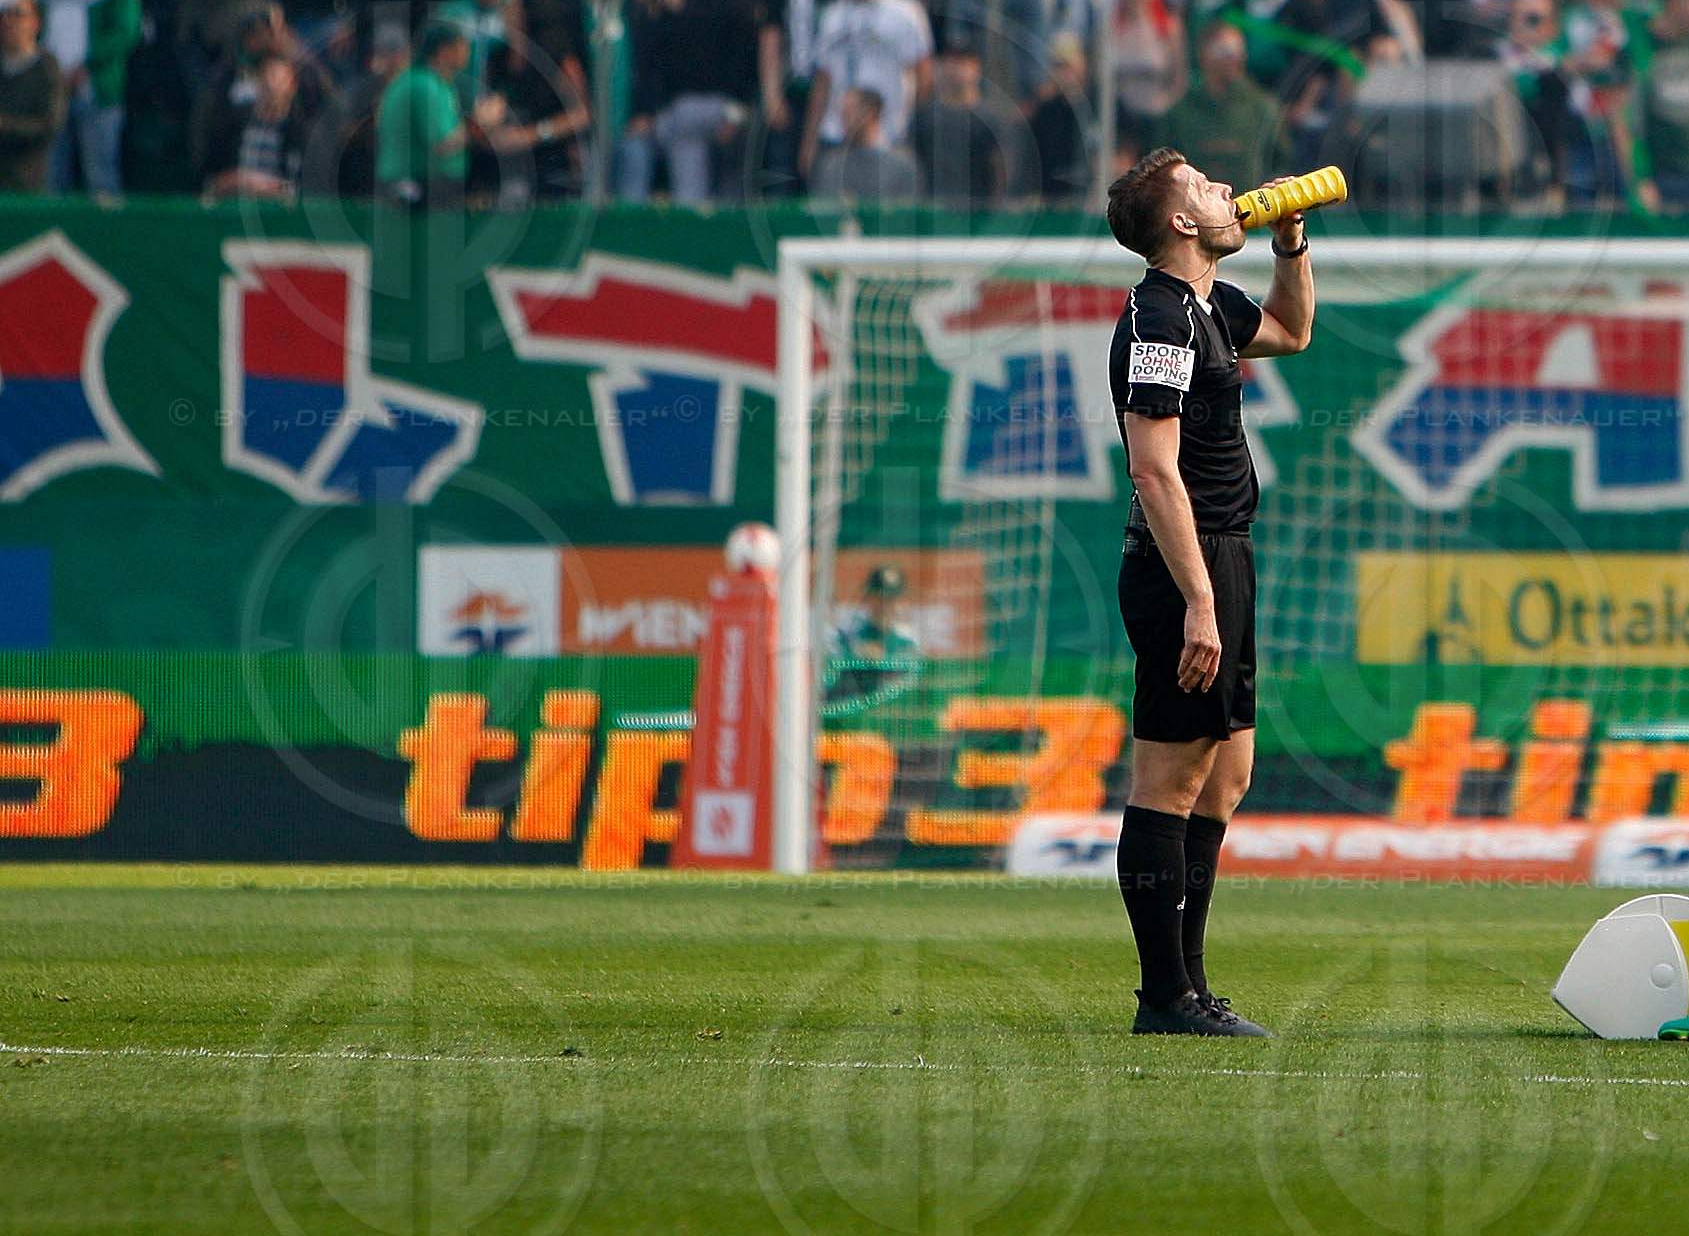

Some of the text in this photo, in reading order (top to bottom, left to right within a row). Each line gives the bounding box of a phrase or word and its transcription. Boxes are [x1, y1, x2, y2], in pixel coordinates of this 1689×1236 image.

[1135, 345, 1190, 362] SPORT
[1142, 356, 1182, 371] OHNE
[1133, 365, 1188, 382] DOPING
